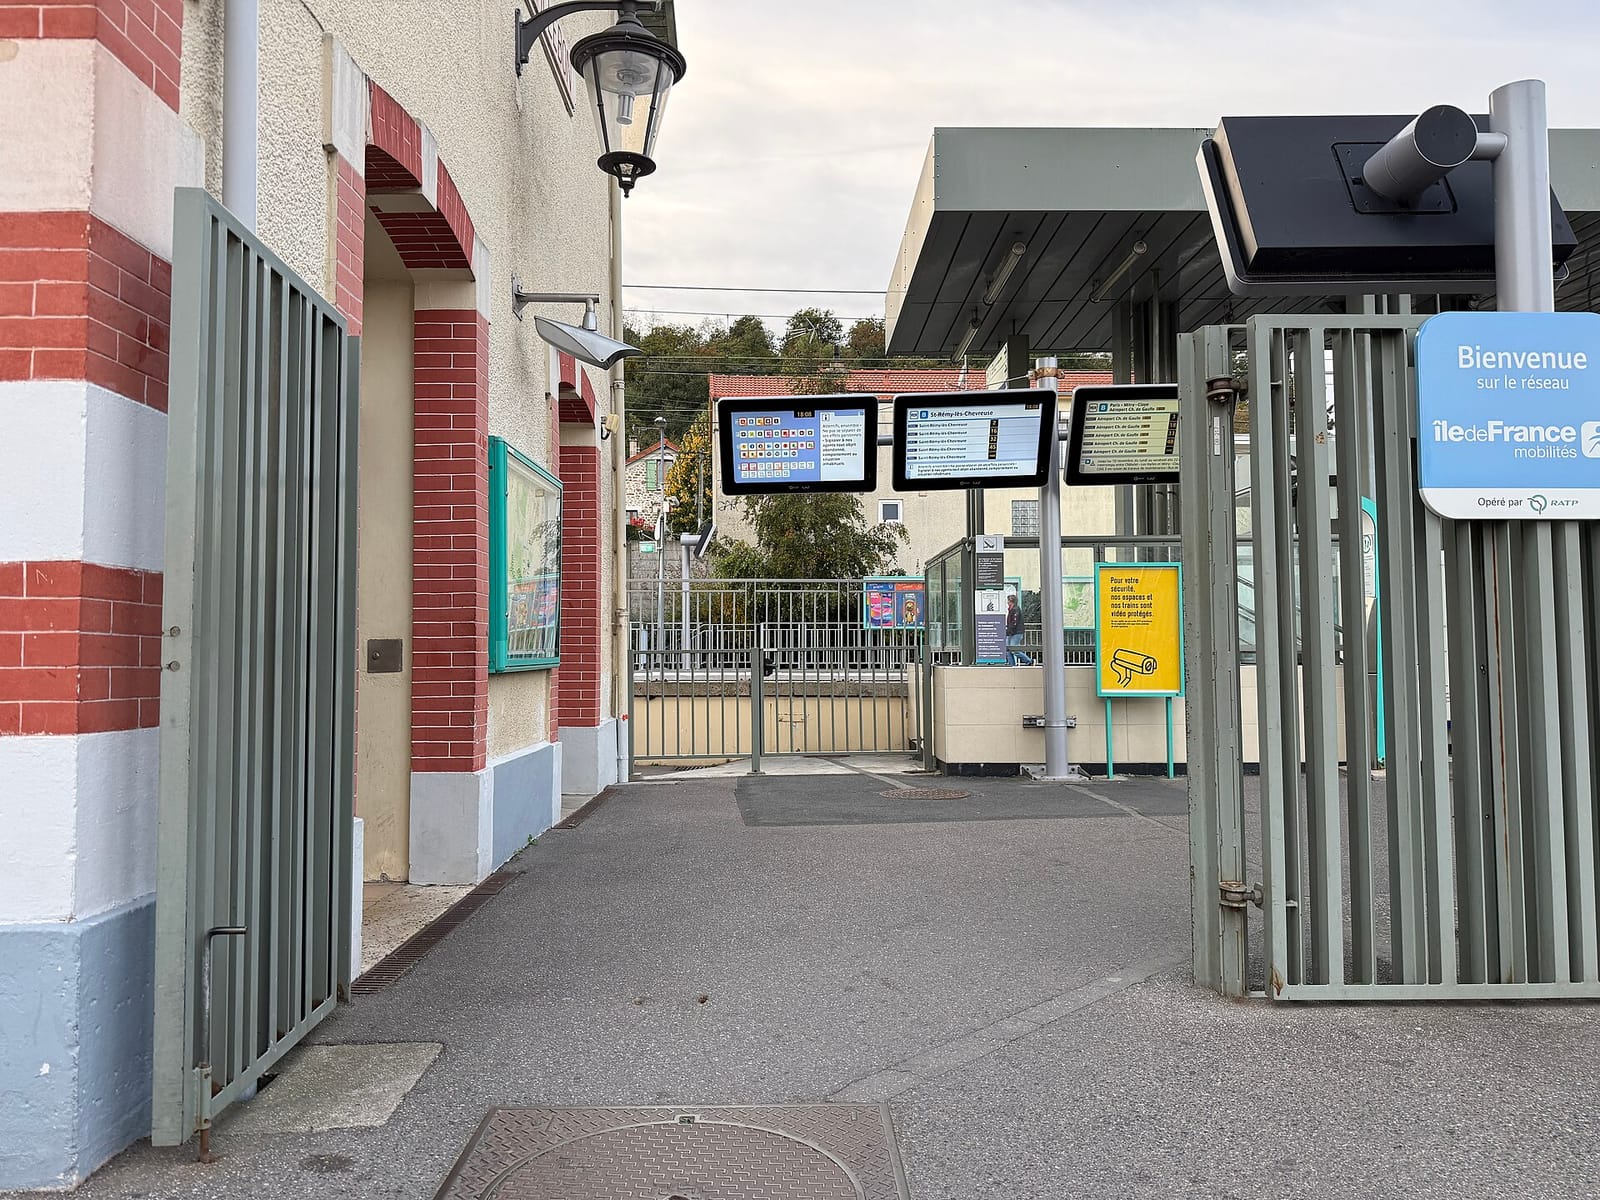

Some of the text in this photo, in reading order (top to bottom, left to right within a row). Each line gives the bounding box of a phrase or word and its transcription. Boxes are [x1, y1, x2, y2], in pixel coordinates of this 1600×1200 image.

[1457, 345, 1588, 370] Bienvenue
[1476, 375, 1569, 390] sur le réseau
[1432, 419, 1577, 443] îledeFrance
[1514, 445, 1577, 459] mobilités
[1477, 497, 1579, 508] Opéré par RATP
